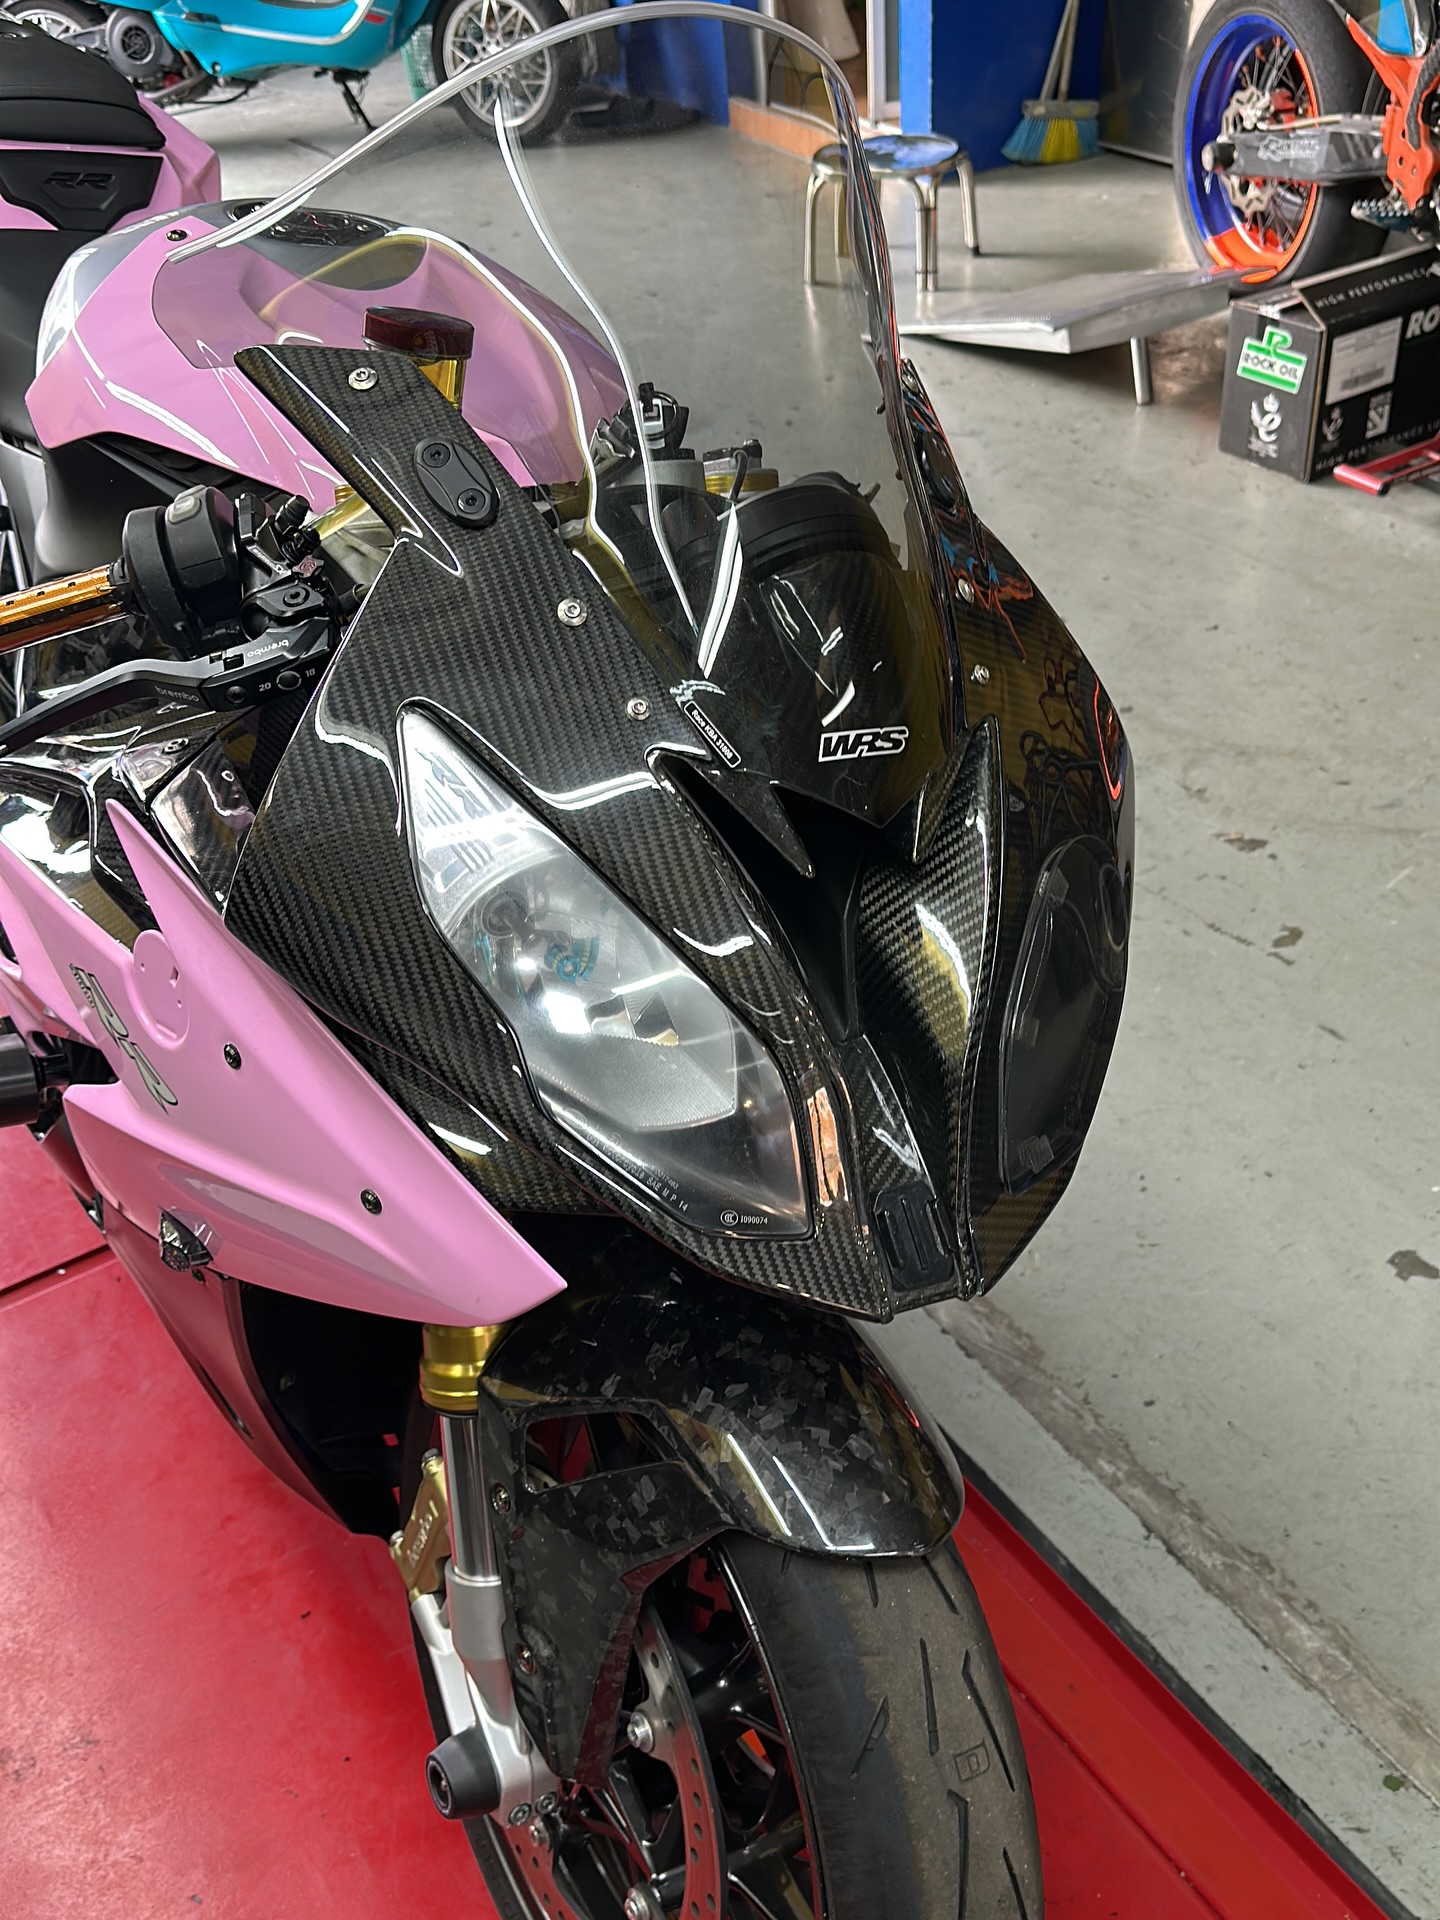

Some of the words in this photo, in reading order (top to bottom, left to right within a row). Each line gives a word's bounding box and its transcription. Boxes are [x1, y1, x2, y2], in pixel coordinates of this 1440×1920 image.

[43, 171, 115, 190] RR
[1242, 352, 1277, 373] ROCK
[1279, 363, 1299, 380] OIL
[247, 638, 290, 658] brembo
[258, 682, 272, 692] 20
[305, 668, 316, 678] 18
[154, 685, 200, 702] brembo
[691, 709, 706, 728] Race
[704, 724, 718, 742] KBA
[819, 726, 909, 762] WRS
[646, 1177, 662, 1192] SAE
[678, 1200, 689, 1212] 14
